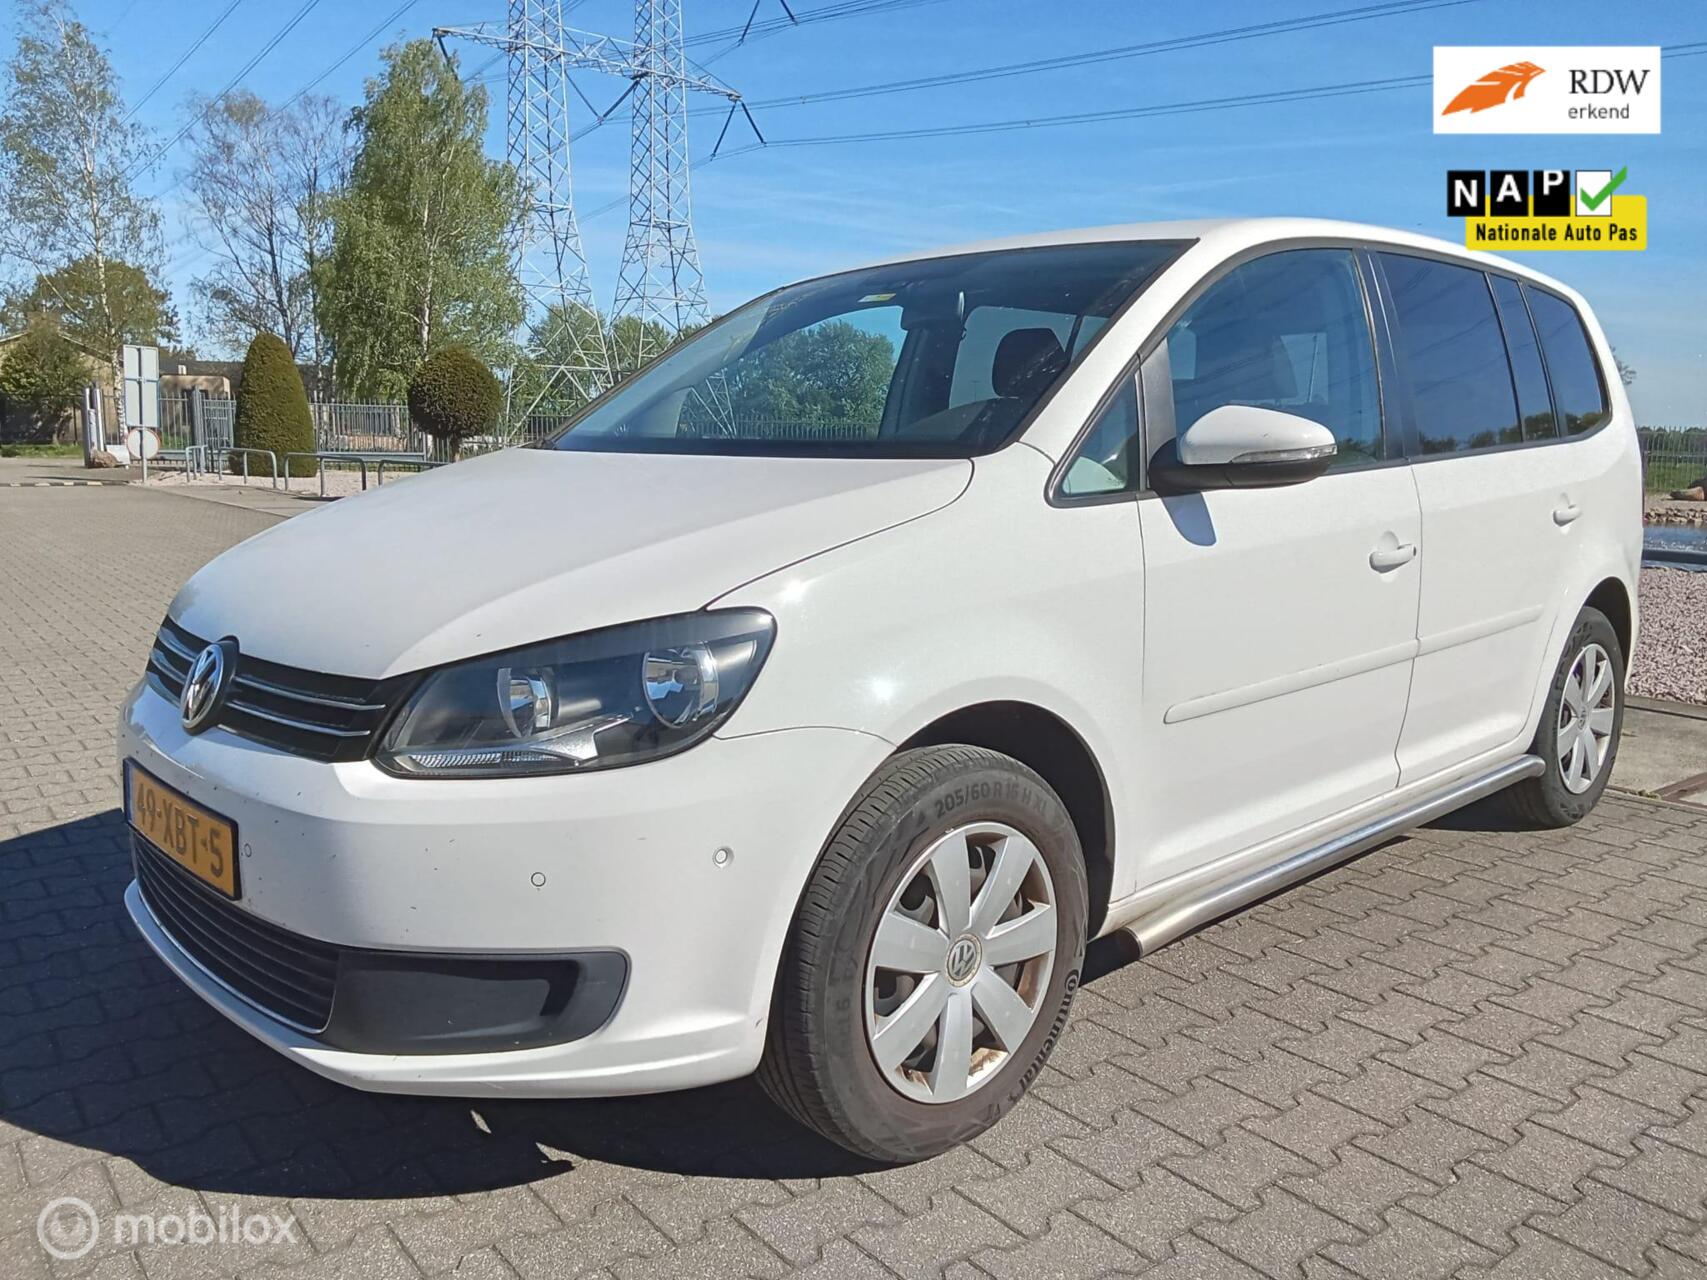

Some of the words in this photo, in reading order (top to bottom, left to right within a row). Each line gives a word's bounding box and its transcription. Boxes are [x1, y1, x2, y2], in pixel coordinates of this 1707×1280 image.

[136, 782, 224, 878] 49-XBT-5
[934, 782, 991, 818] 205/60
[1019, 969, 1080, 1089] Continental
